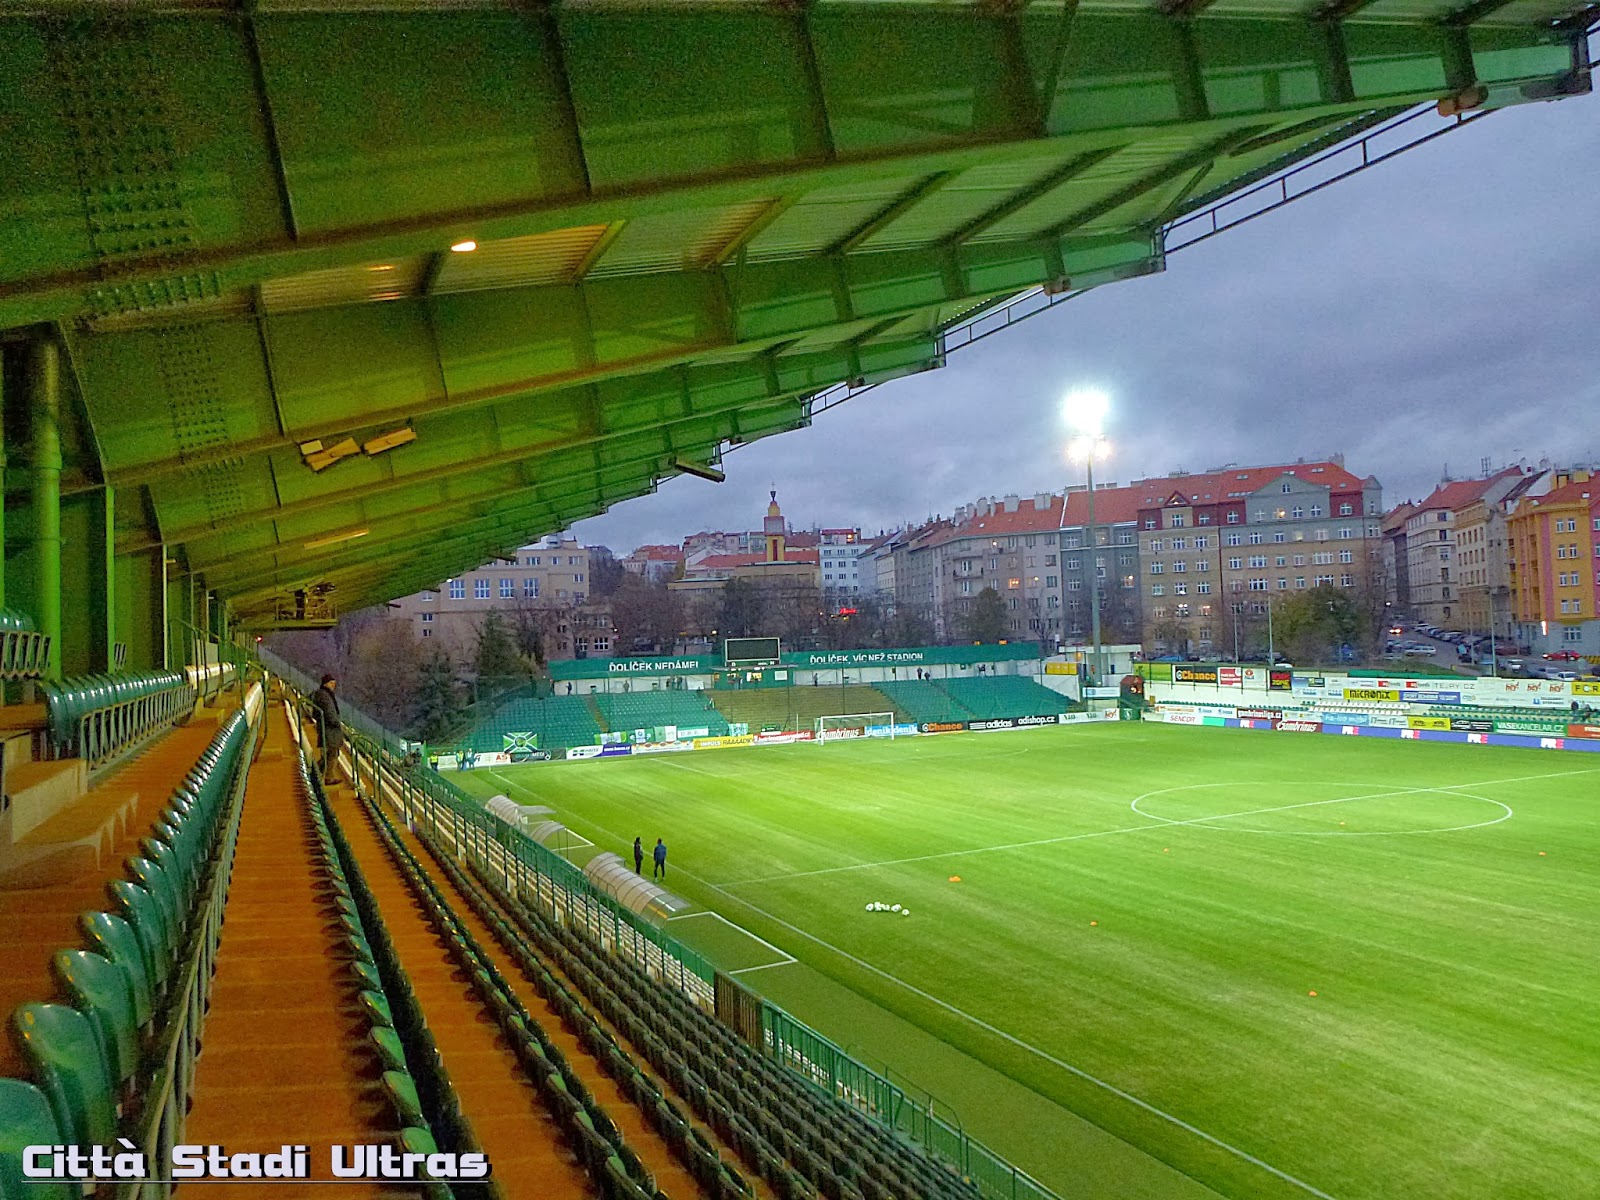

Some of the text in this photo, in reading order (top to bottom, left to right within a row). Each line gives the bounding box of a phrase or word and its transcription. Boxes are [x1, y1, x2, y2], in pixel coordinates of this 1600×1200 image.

[887, 653, 923, 662] STADION
[986, 720, 1013, 729] adidas
[1018, 715, 1055, 725] adishop.cz
